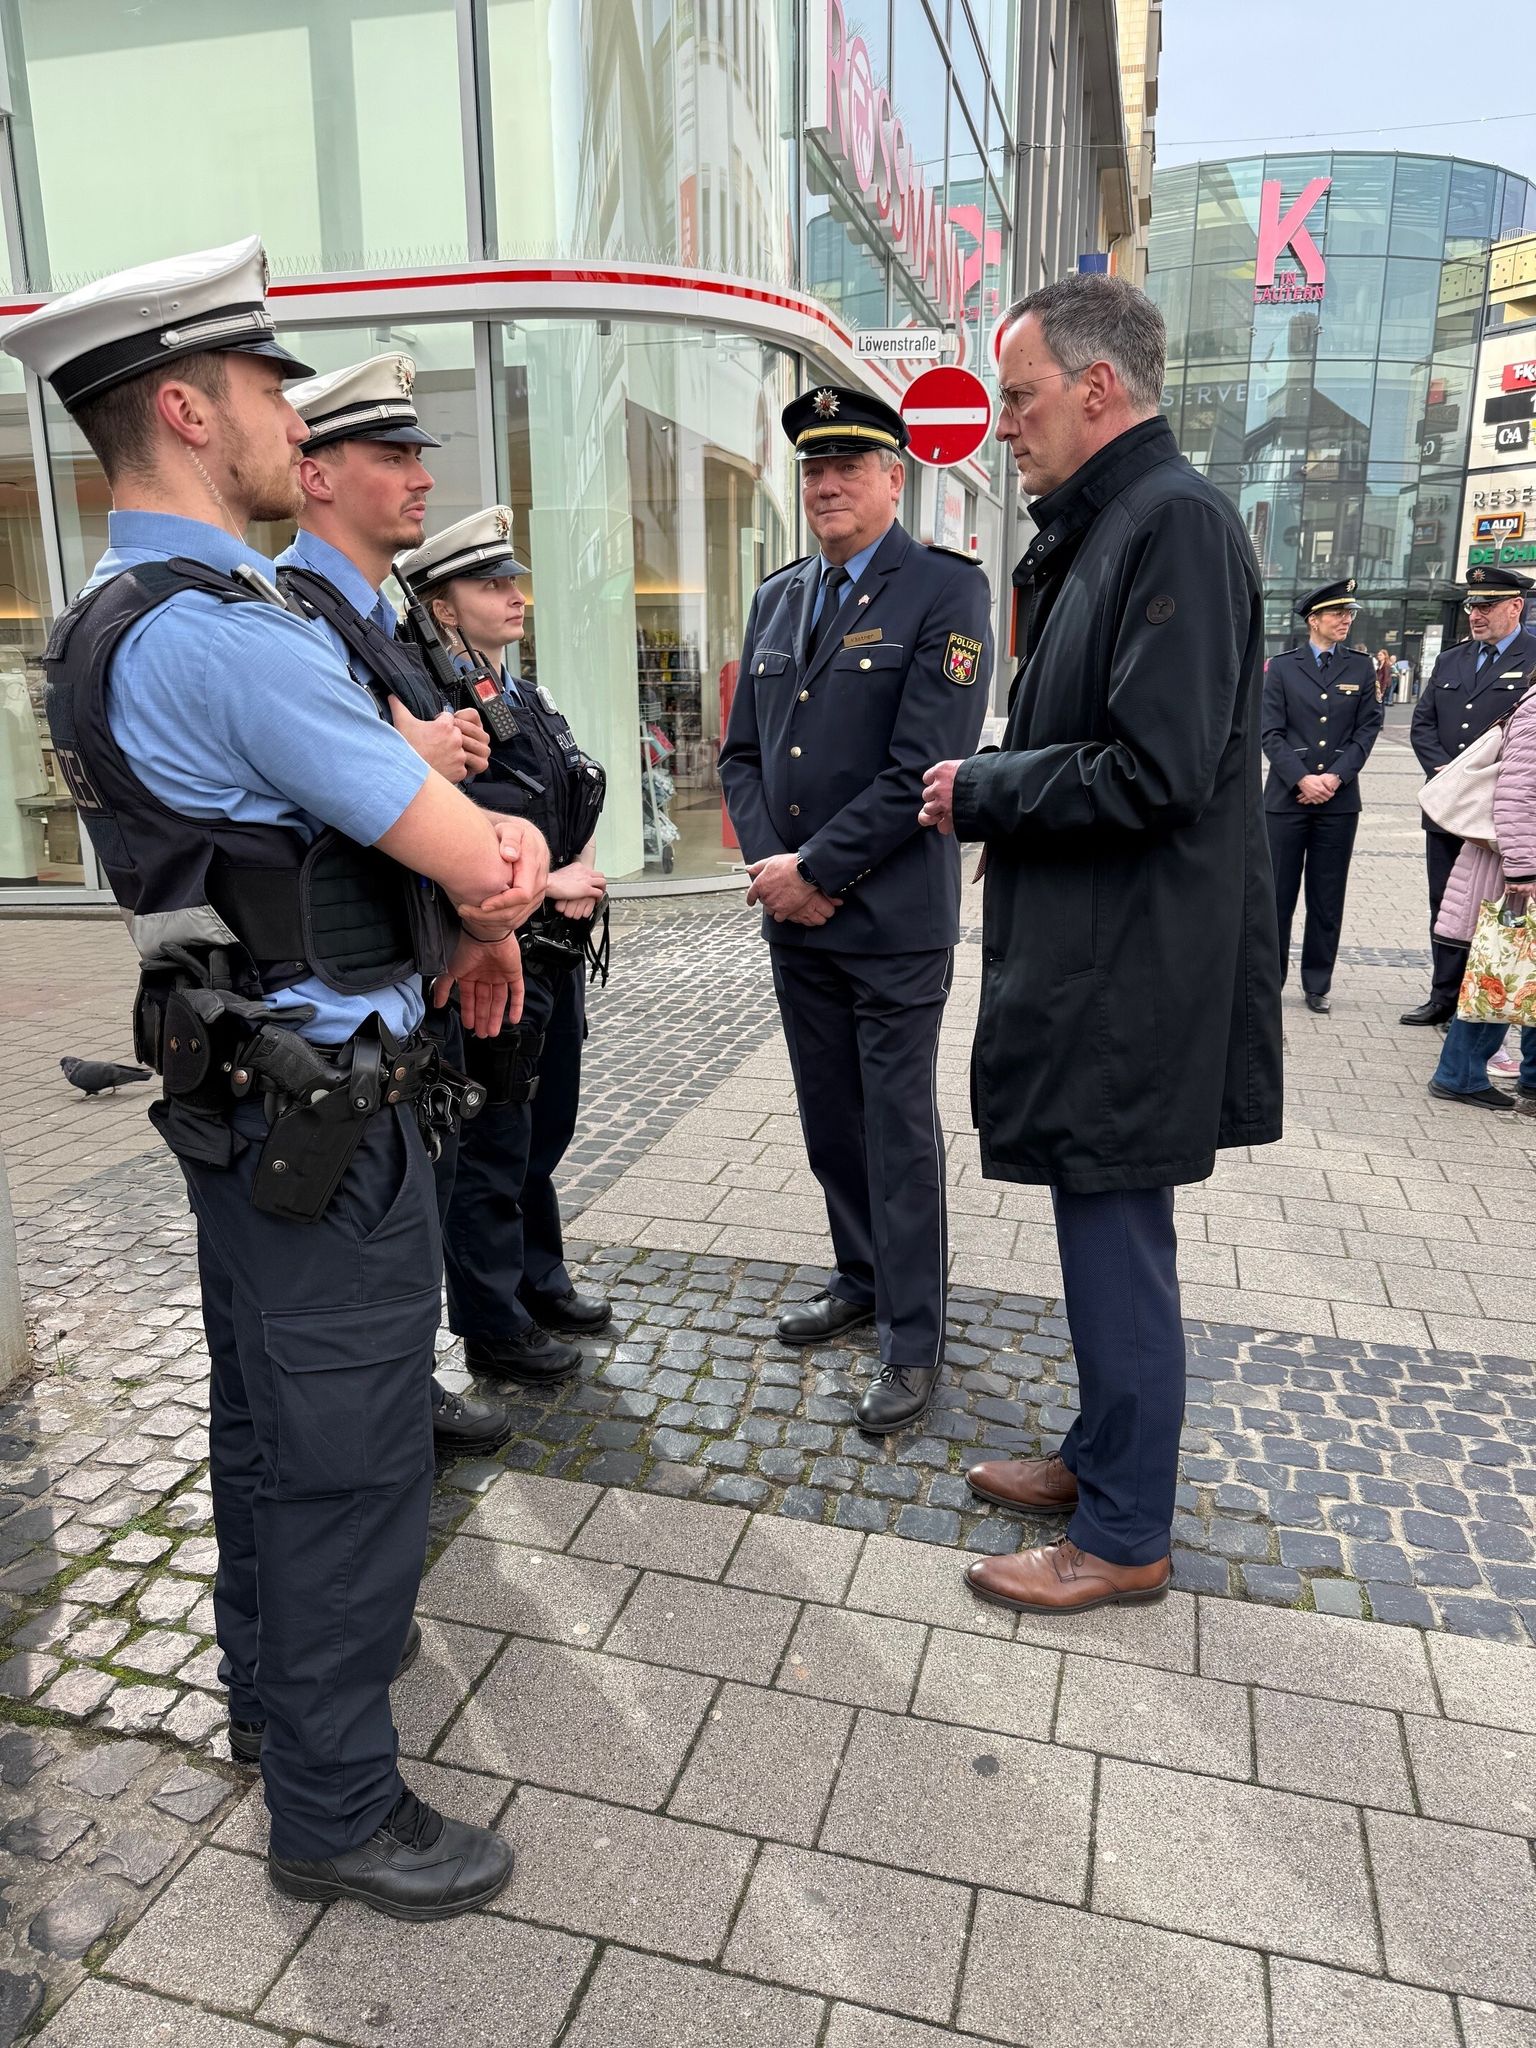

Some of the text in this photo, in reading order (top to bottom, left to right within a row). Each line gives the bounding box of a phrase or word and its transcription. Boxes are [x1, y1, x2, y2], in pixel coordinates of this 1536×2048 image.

[1255, 177, 1332, 286] K
[858, 335, 937, 352] Löwenstraße
[1160, 384, 1271, 407] SERVED
[1473, 485, 1536, 508] RESE
[1491, 518, 1519, 530] ALDI
